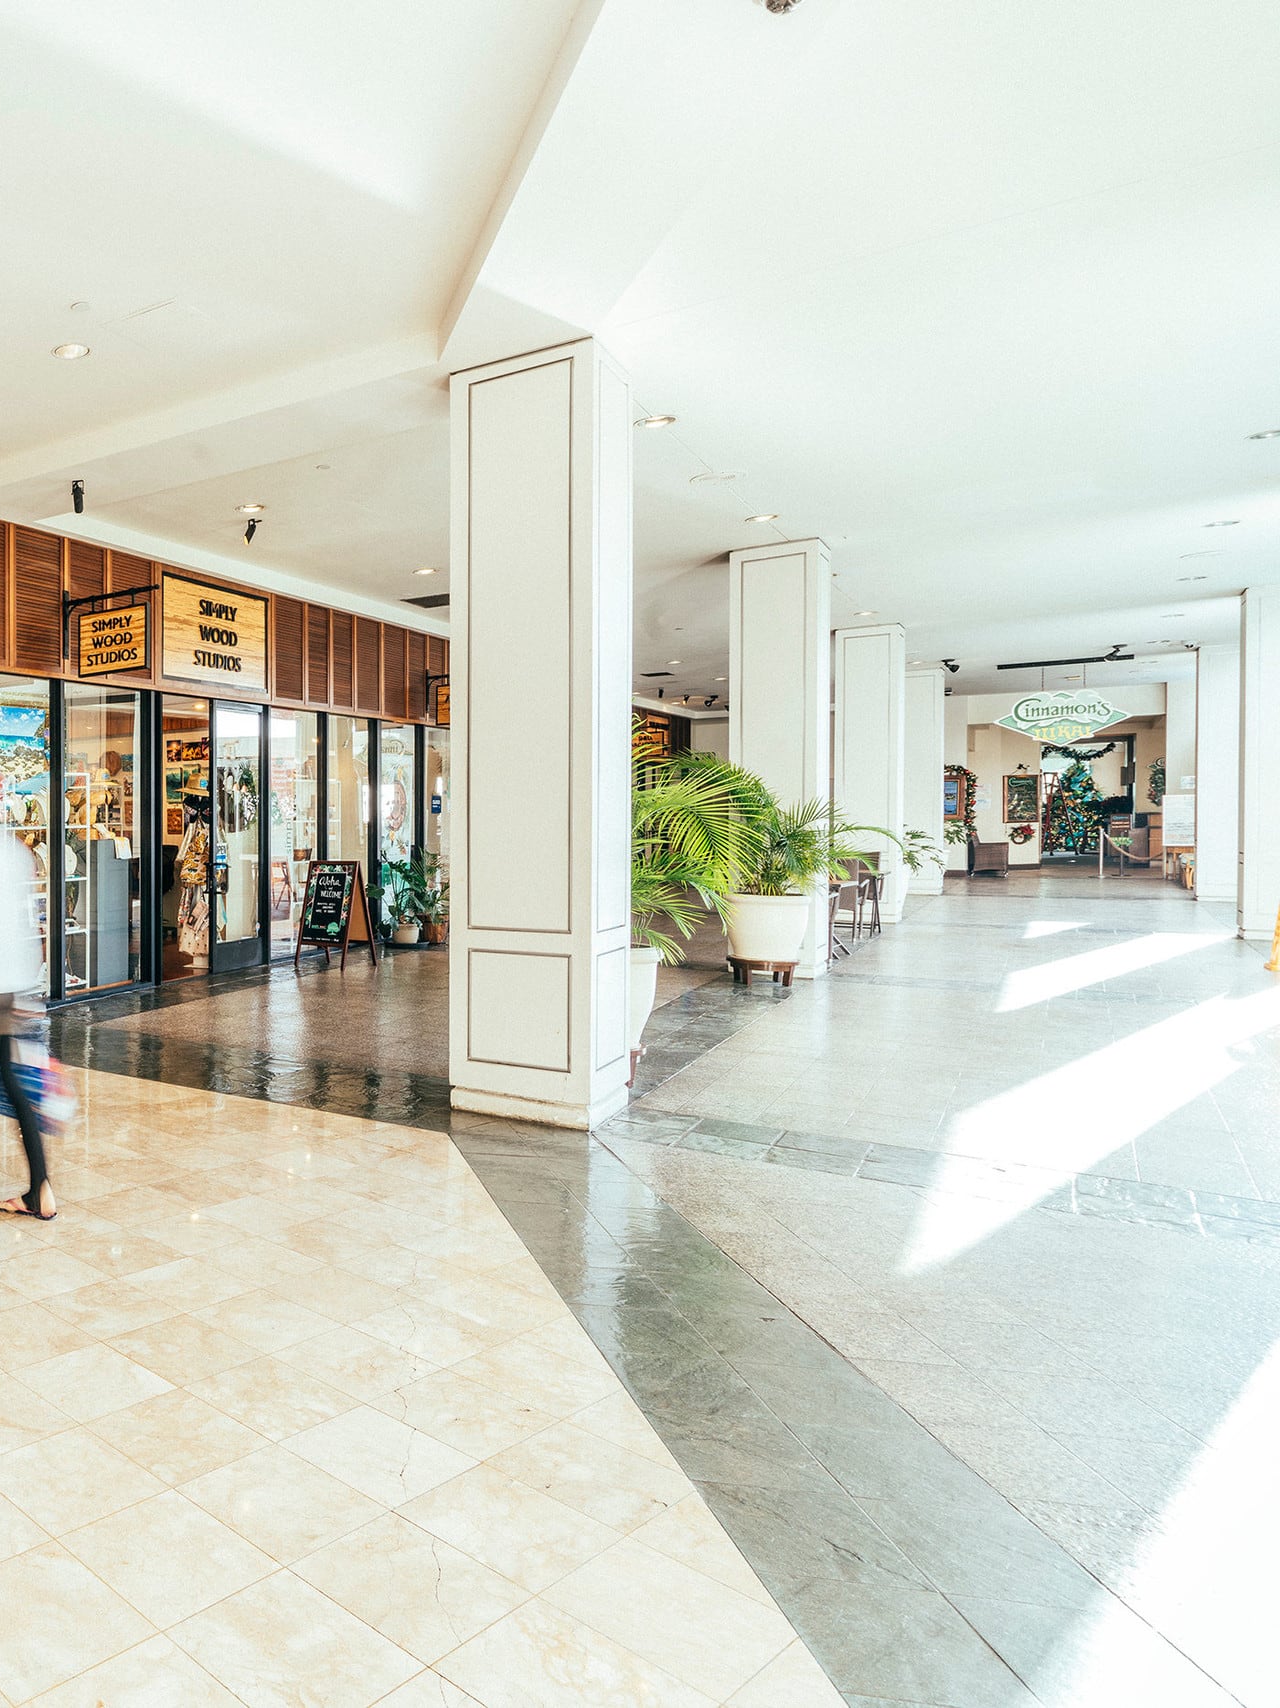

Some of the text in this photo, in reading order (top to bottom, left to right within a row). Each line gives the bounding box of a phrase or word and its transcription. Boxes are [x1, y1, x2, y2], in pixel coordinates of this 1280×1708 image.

[199, 599, 238, 622] SIMPLY
[91, 614, 133, 633] SIMPLY
[91, 631, 133, 649] WOOD
[199, 624, 238, 647] WOOD
[86, 647, 138, 667] STUDIOS
[193, 650, 242, 673] STUDIOS
[1013, 698, 1111, 723] Cinnamon's
